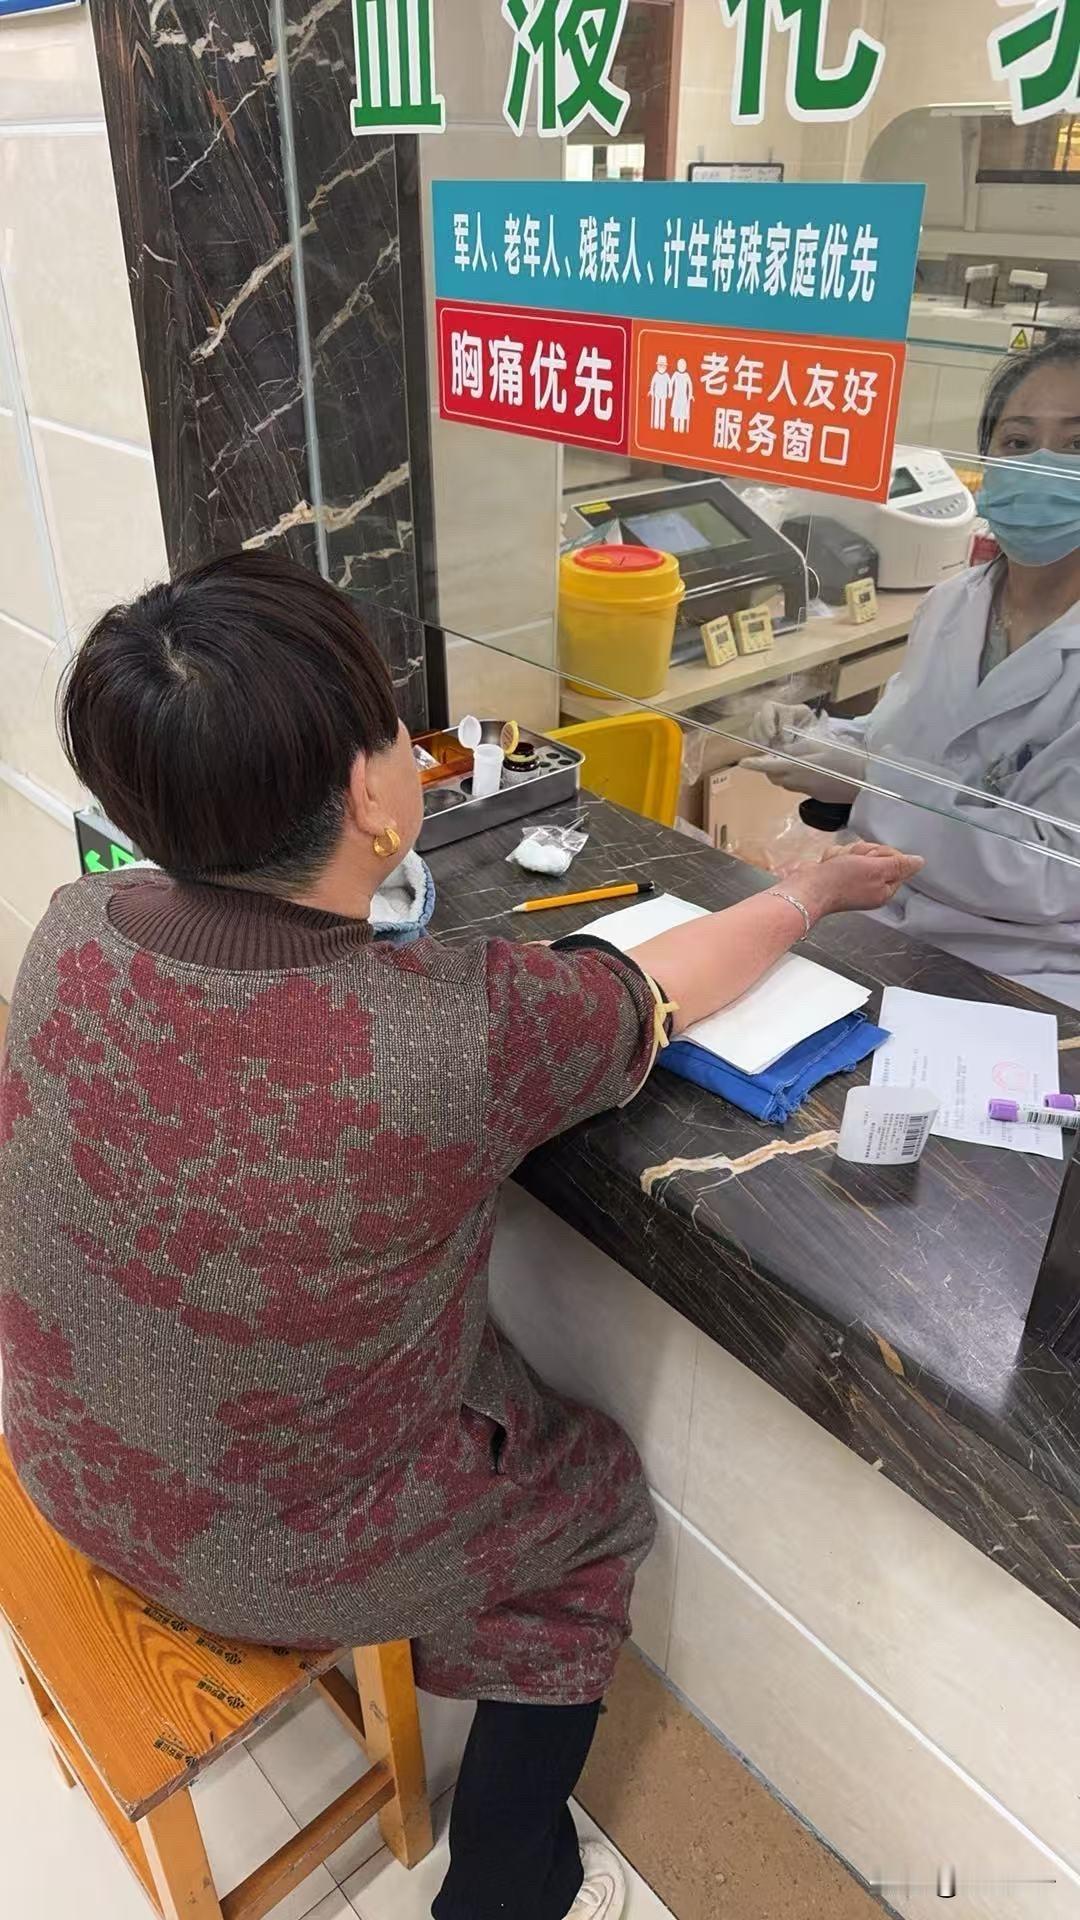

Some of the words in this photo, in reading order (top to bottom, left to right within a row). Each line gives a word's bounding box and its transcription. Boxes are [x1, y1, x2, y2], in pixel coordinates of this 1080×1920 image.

[453, 211, 879, 303] 军人、老年人、残疾人、计生特殊家庭优先
[450, 330, 613, 421] 胸痛优先
[700, 351, 879, 417] 老年人友好
[713, 407, 851, 466] 服务窗口
